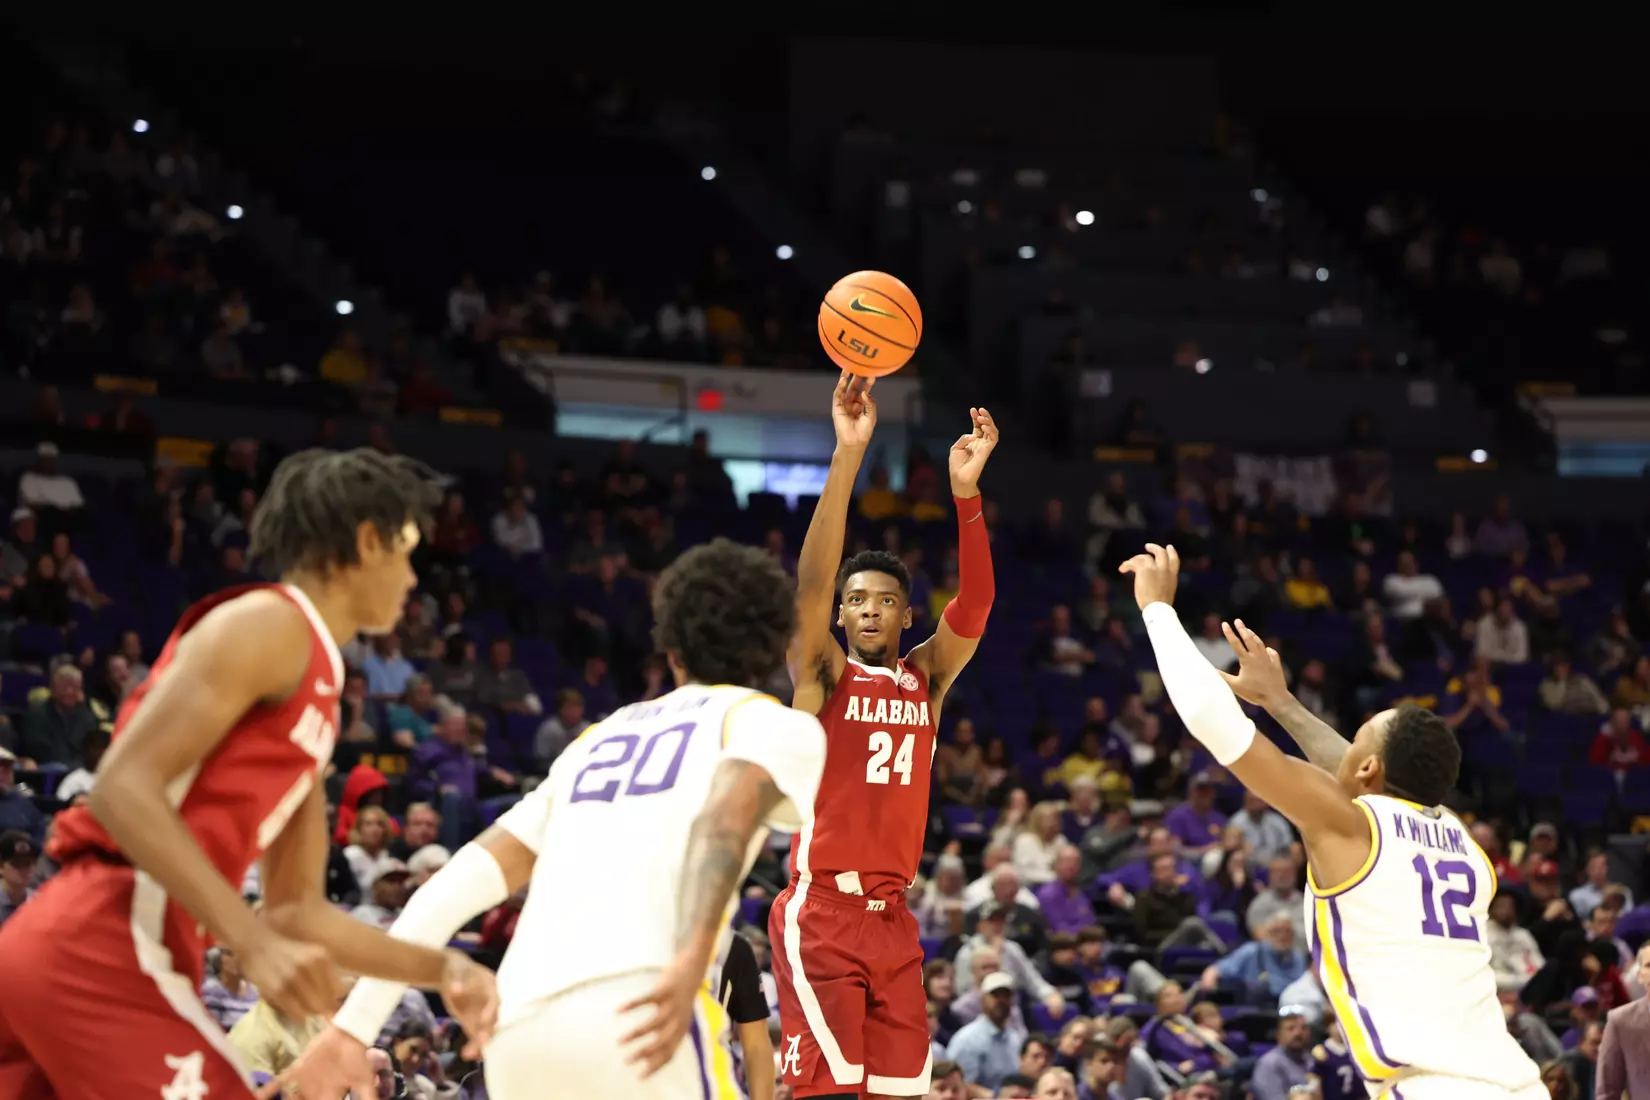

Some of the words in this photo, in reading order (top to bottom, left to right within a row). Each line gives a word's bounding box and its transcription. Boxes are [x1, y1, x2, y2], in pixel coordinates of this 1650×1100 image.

[837, 329, 879, 359] LSU
[569, 722, 698, 803] 20
[865, 730, 916, 785] 24
[1412, 853, 1480, 942] 12
[781, 1033, 802, 1077] A
